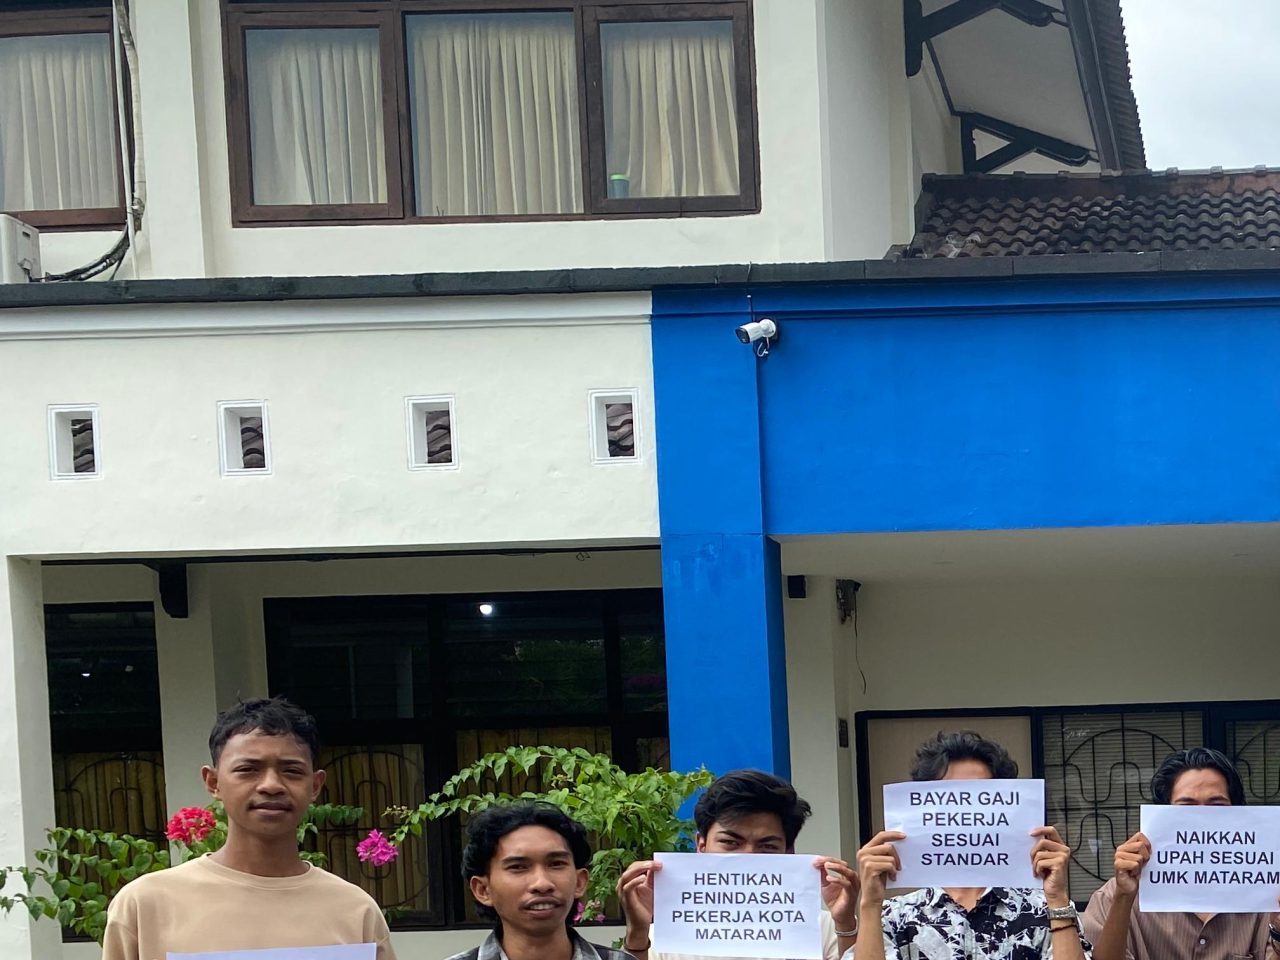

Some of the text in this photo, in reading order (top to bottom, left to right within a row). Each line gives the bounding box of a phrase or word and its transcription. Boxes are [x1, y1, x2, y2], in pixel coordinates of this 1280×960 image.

[910, 792, 1019, 806] BAYAR GAJI
[923, 813, 1009, 826] PEKERJA
[932, 833, 999, 847] SESUAI
[1177, 831, 1255, 844] NAIKKAN
[921, 853, 1008, 865] STANDAR
[1157, 851, 1273, 864] UPAH SESUAI
[695, 873, 781, 885] HENTIKAN
[1150, 871, 1280, 884] UMK MATARAM
[682, 892, 795, 906] PENINDASAN
[672, 910, 805, 923] PEKERJA KOTA
[696, 929, 781, 940] MATARAM
